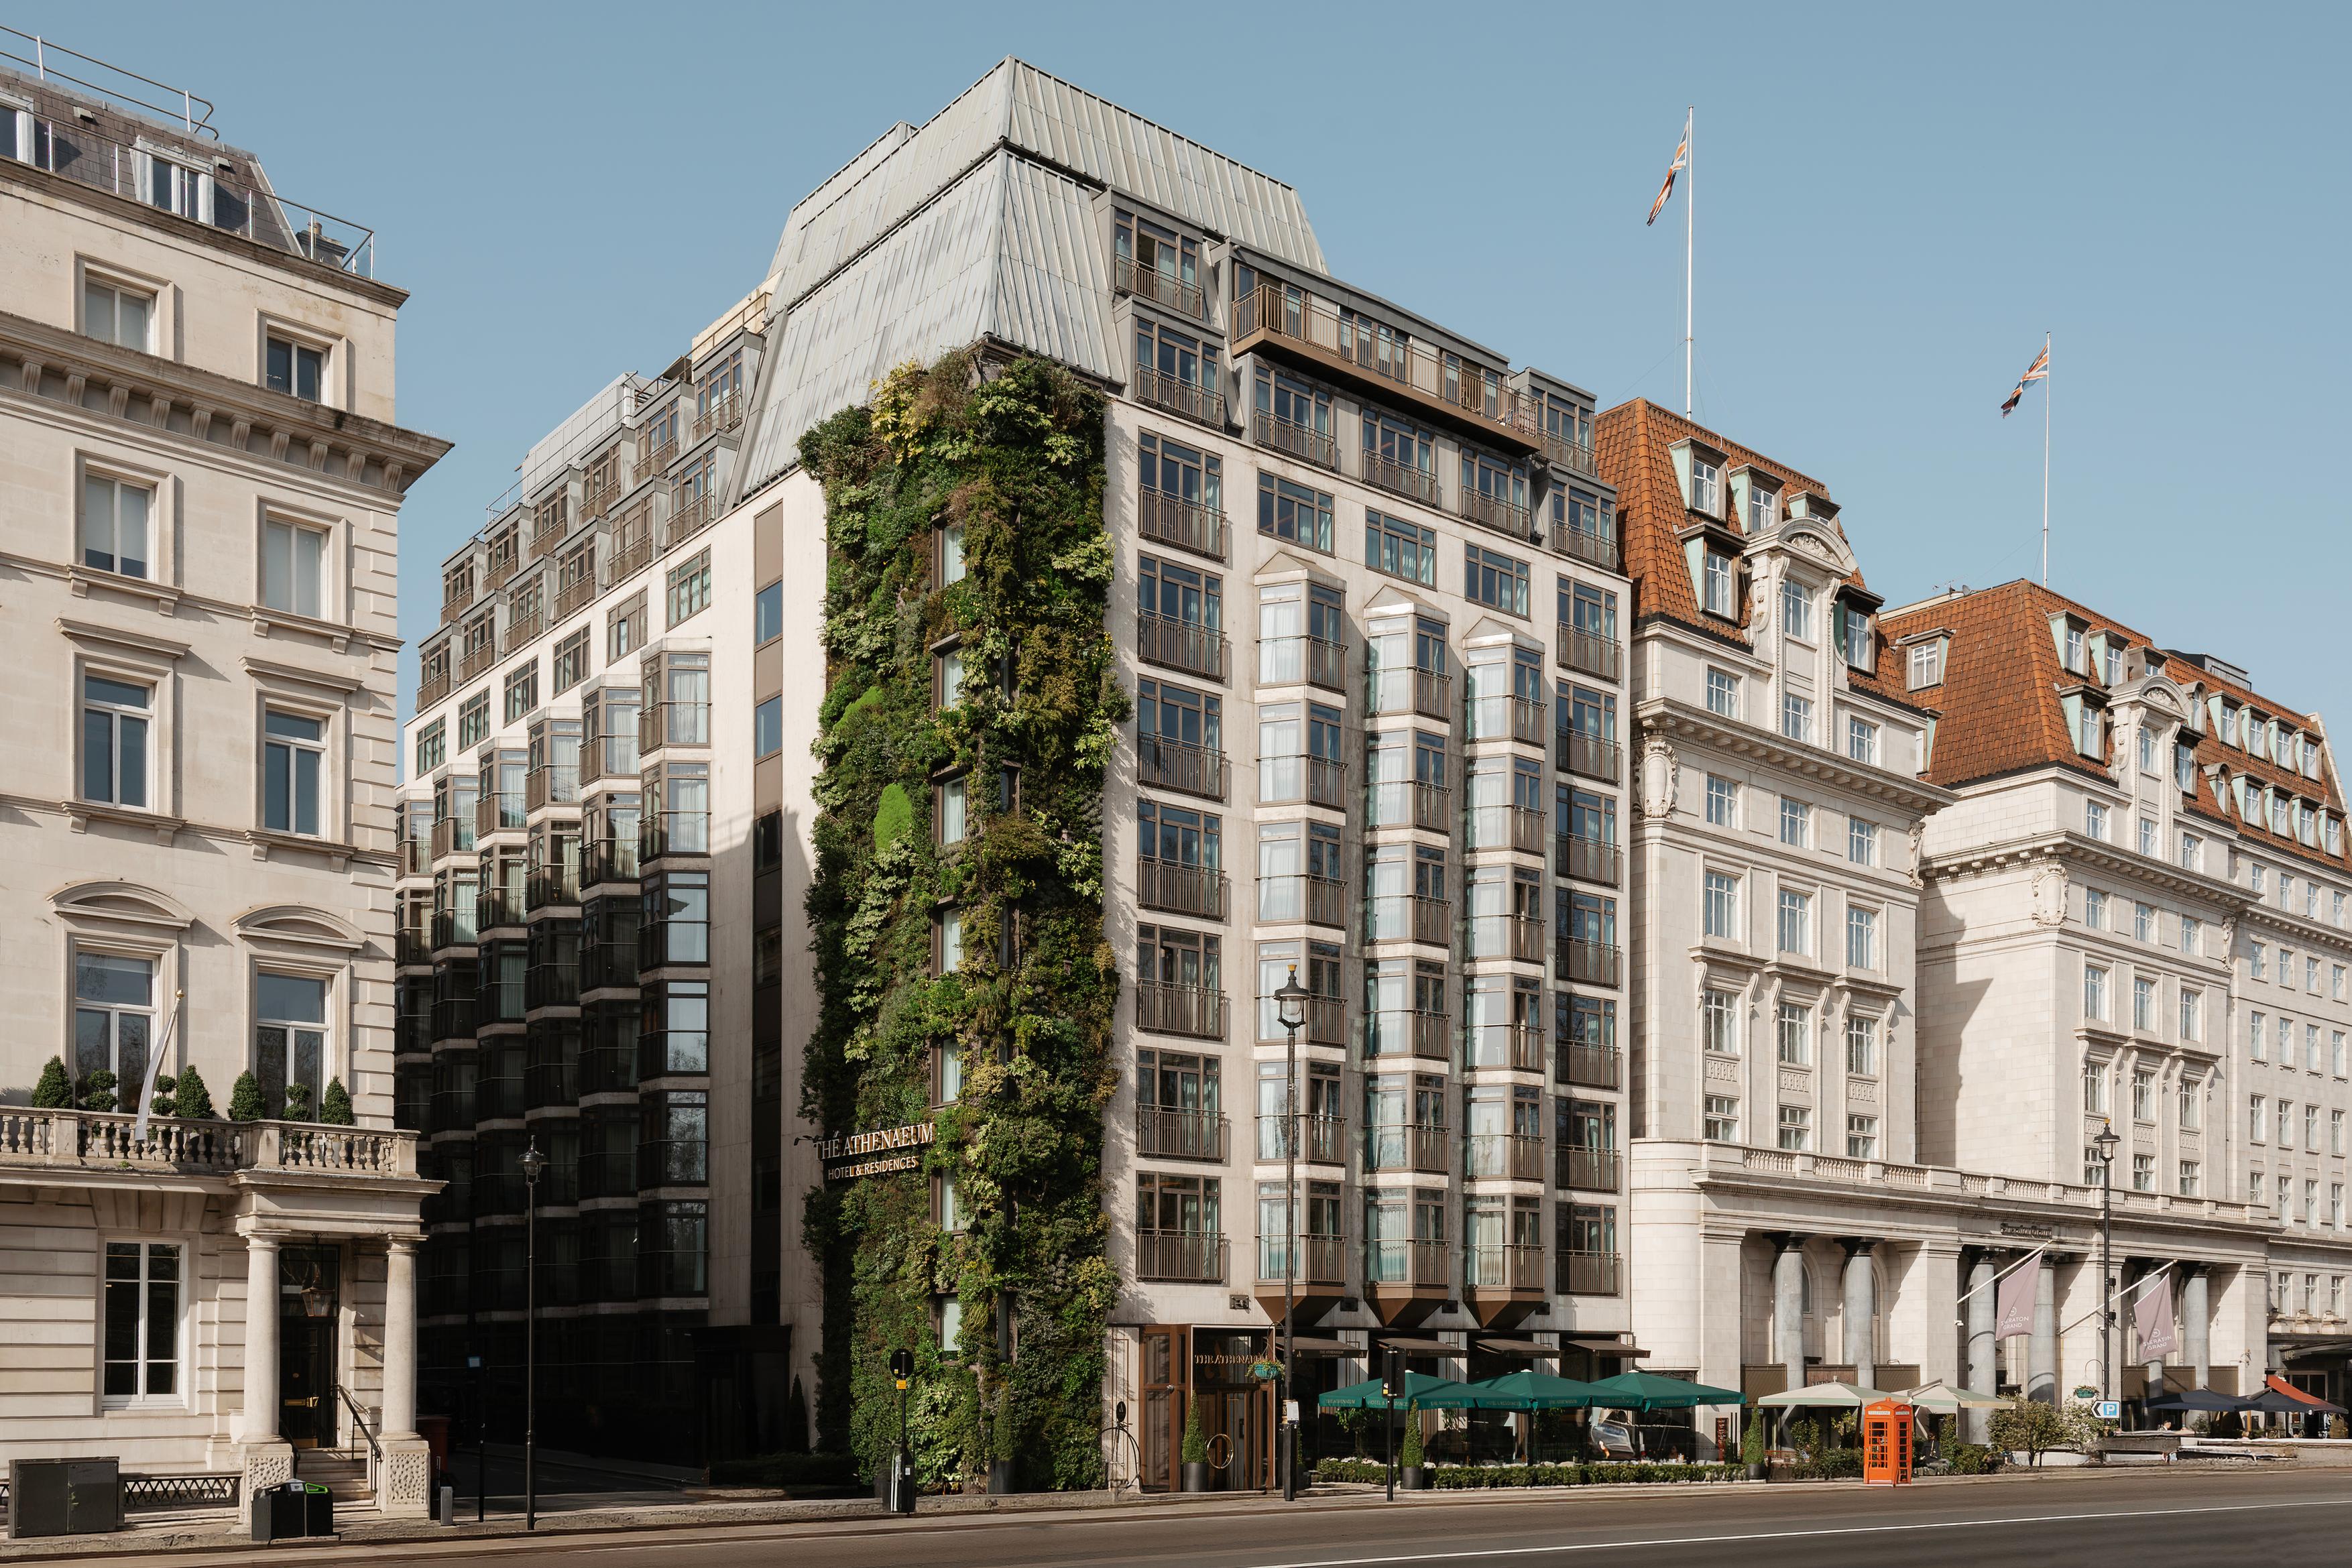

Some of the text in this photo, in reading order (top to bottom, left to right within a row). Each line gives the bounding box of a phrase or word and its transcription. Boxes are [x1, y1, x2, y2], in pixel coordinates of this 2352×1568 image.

[813, 1122, 933, 1160] THE ATHENAEUM
[828, 1156, 917, 1181] HOTEL & RESIDENCES
[2148, 1342, 2167, 1350] GRAND
[1194, 1354, 1214, 1364] THE
[2106, 1404, 2115, 1415] P
